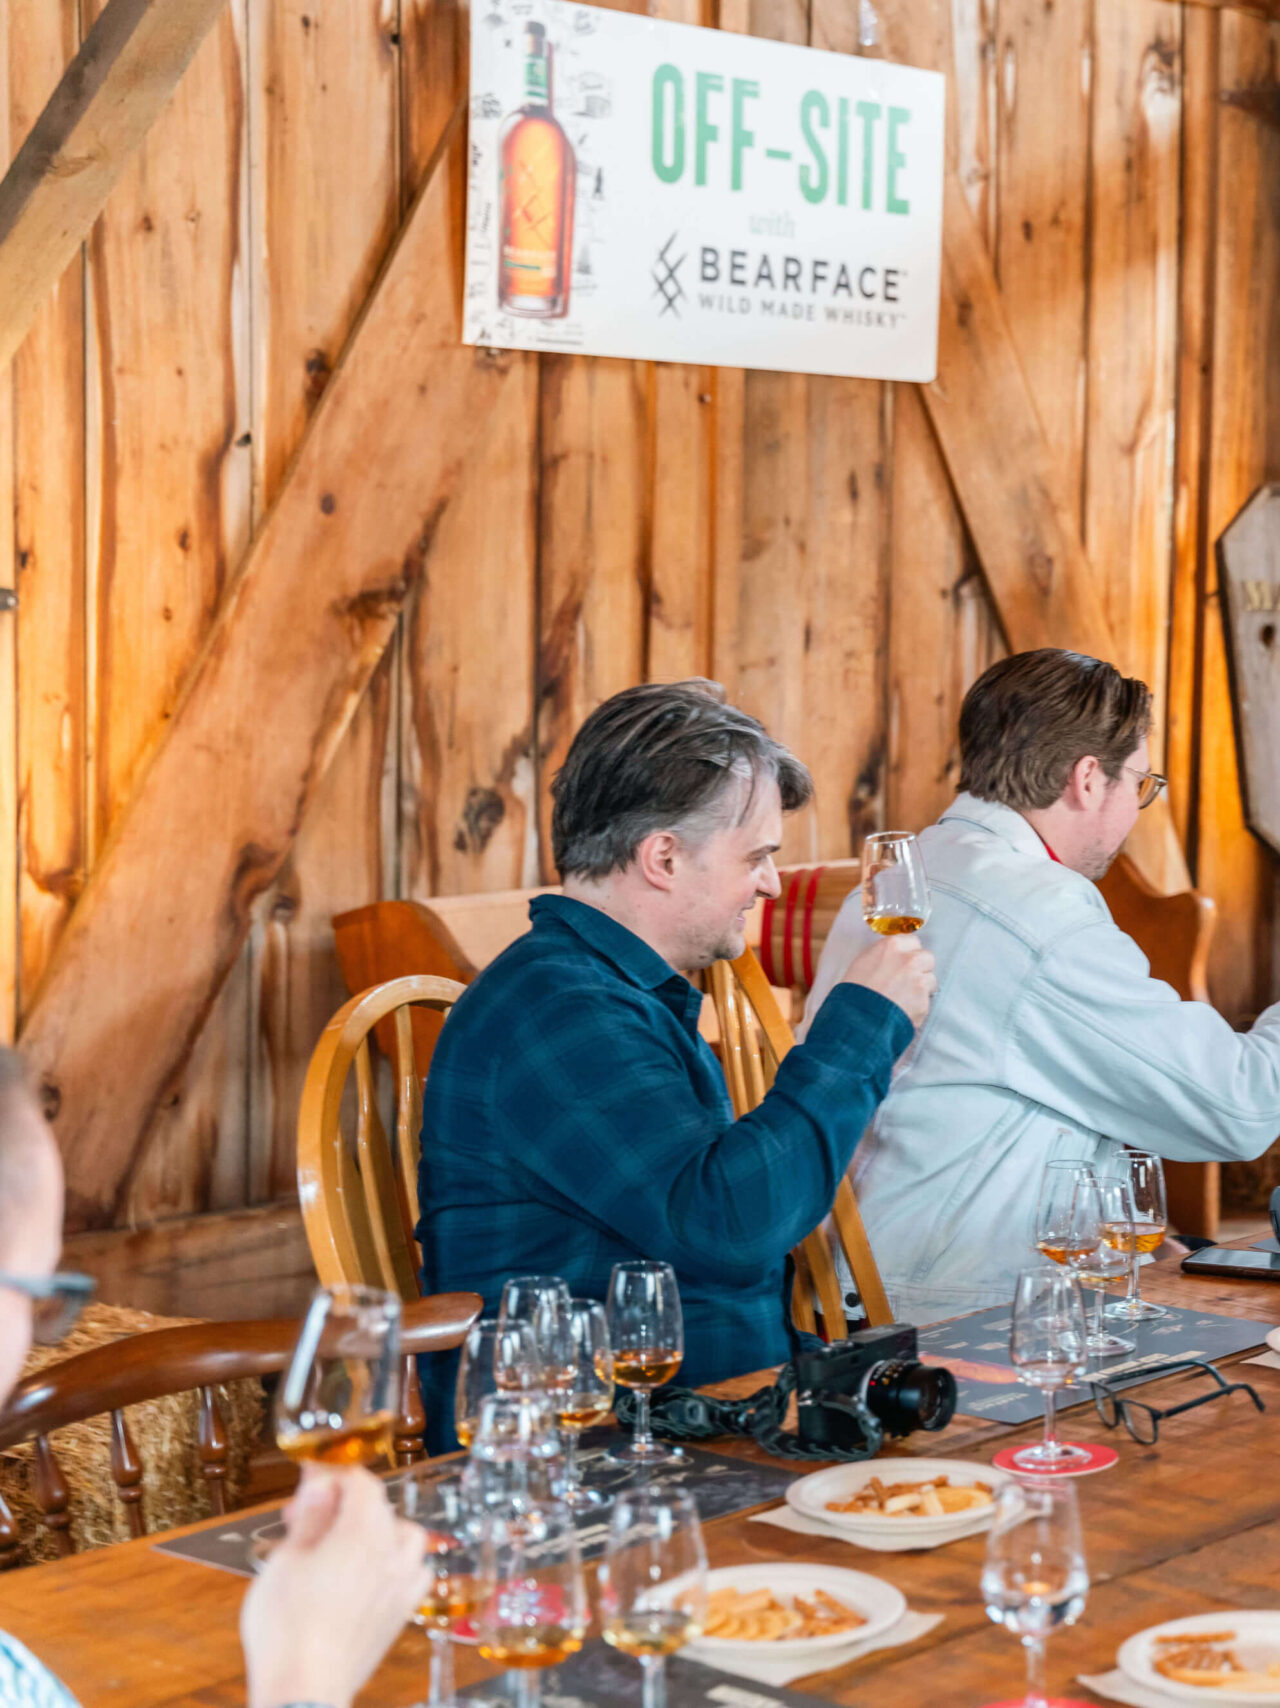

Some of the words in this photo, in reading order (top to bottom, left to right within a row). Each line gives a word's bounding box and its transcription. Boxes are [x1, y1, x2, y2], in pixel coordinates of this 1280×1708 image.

[652, 63, 911, 215] OFF-SITE
[749, 212, 796, 238] with
[701, 246, 900, 302] BEARFACE
[699, 294, 751, 314] WILD
[761, 300, 816, 321] MADE
[825, 307, 901, 329] WHISKY
